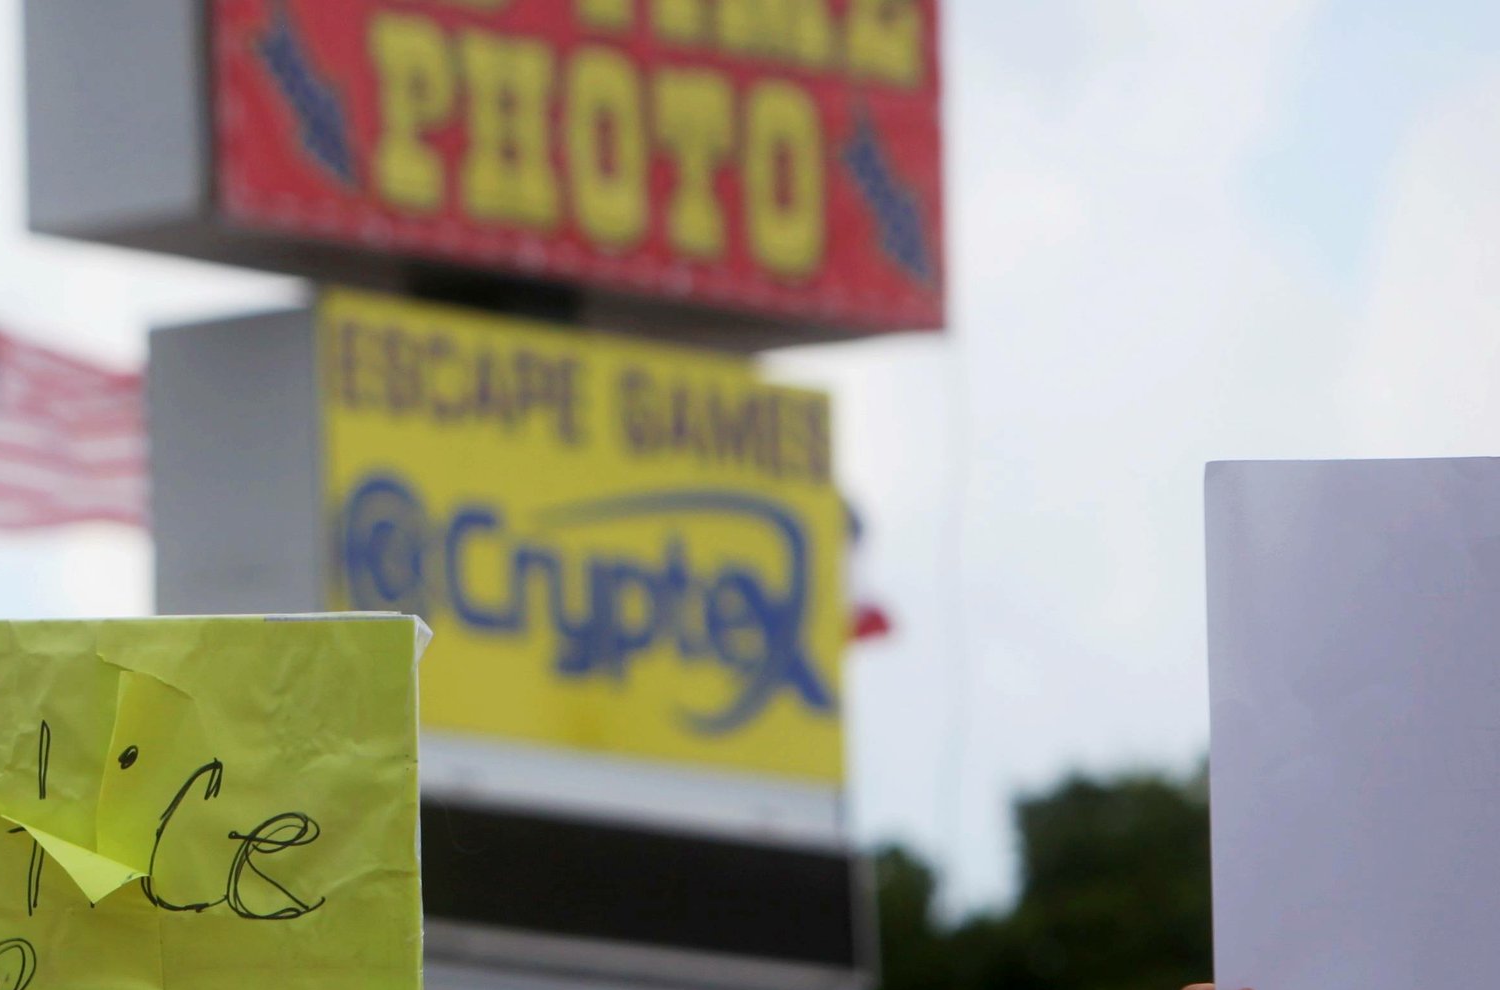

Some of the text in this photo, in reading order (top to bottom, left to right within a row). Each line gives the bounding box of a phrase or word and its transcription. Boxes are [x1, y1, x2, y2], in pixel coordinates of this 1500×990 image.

[369, 12, 829, 282] PHOTO
[336, 318, 833, 486] ESCAPE GAMES
